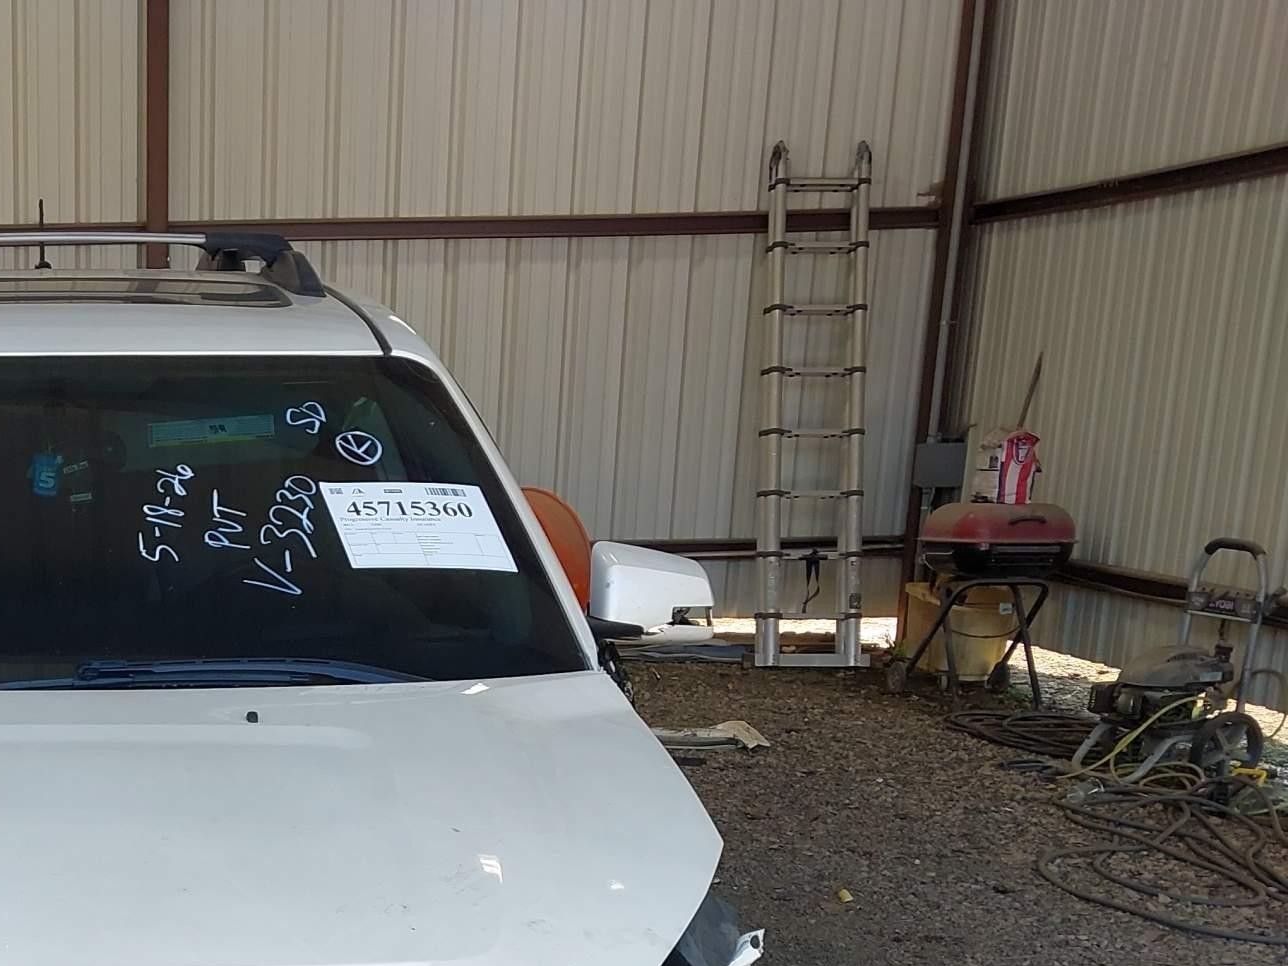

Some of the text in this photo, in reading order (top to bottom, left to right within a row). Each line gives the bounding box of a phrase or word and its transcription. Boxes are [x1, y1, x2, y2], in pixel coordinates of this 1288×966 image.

[336, 432, 379, 464] K
[138, 464, 195, 562] 5-18-26
[242, 475, 317, 595] V-3230
[346, 500, 473, 518] 45715360
